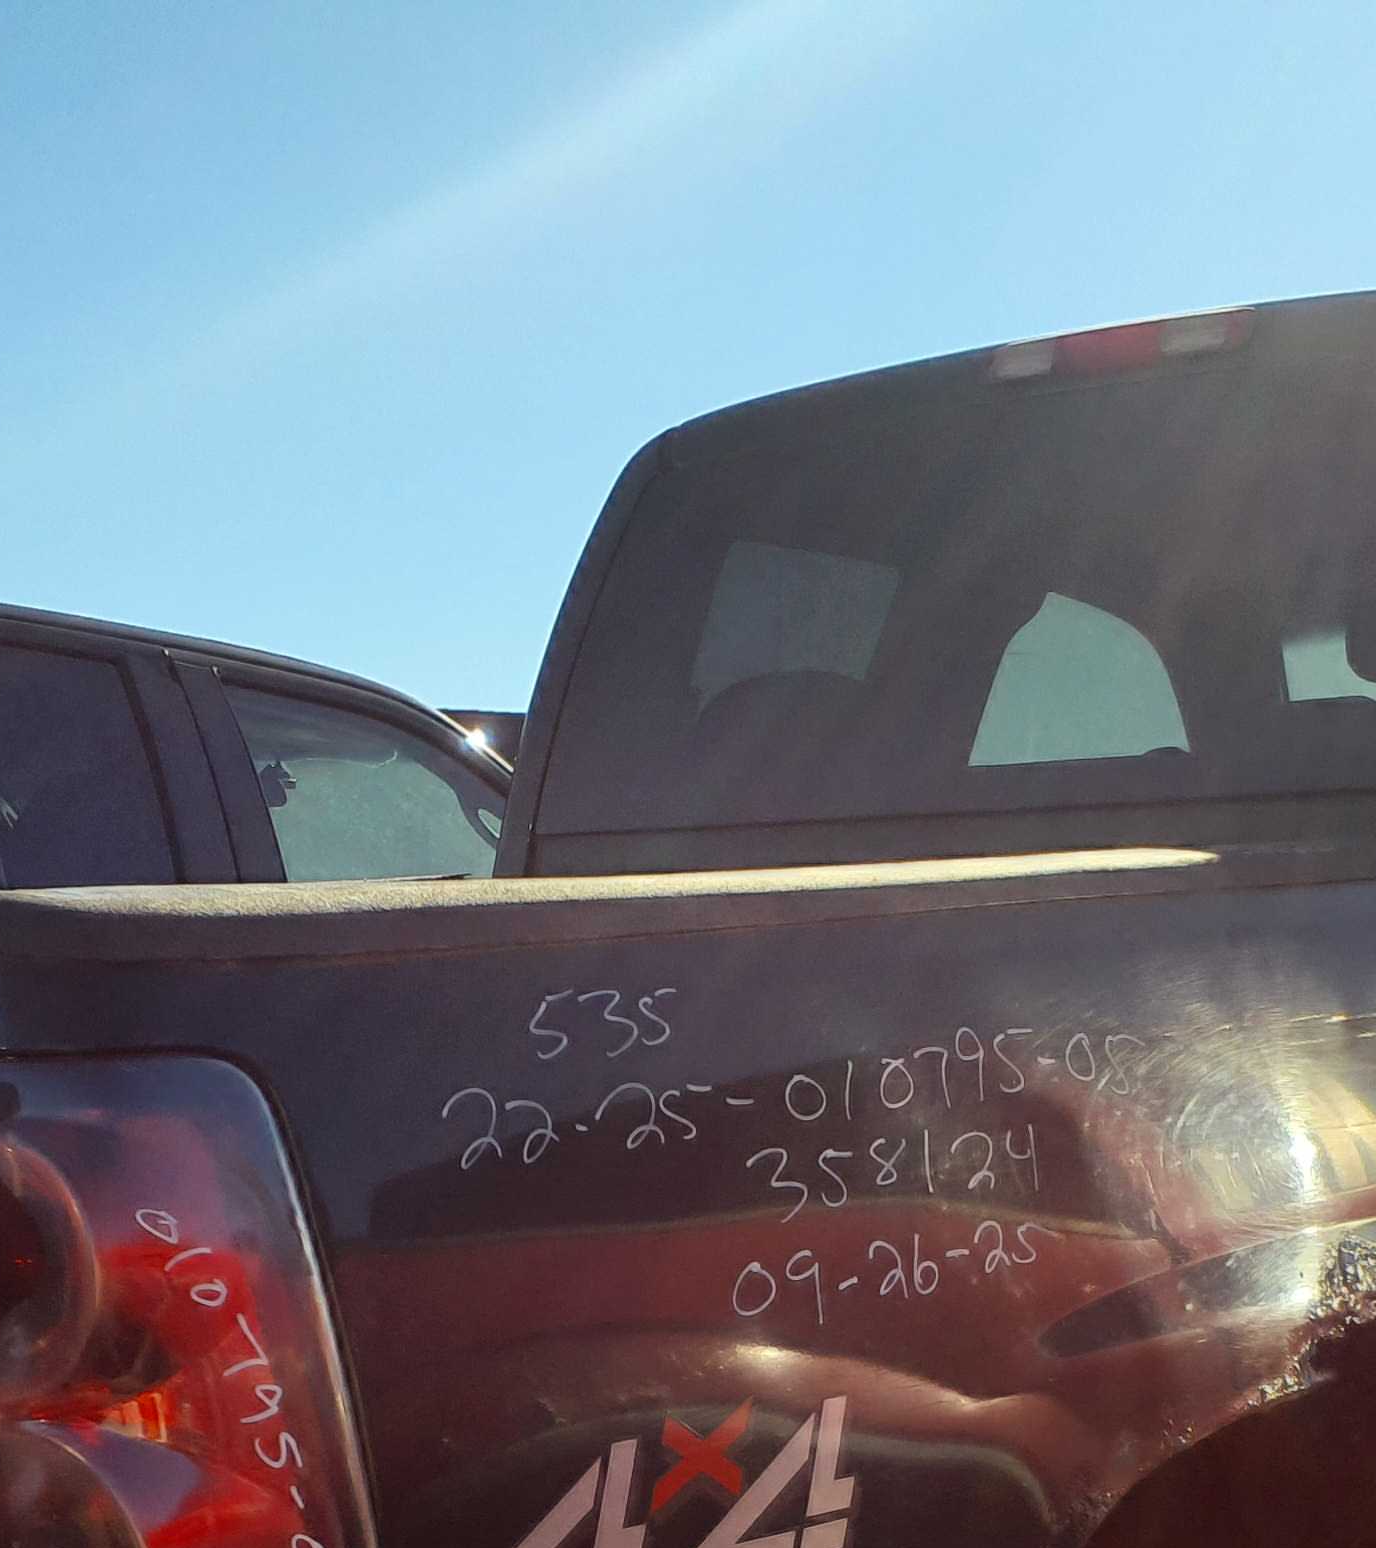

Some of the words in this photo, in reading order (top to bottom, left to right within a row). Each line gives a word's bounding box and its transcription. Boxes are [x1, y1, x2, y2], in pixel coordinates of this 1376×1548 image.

[527, 987, 677, 1060] 535
[747, 1124, 1040, 1223] 358124
[732, 1219, 1054, 1325] 09-26-25
